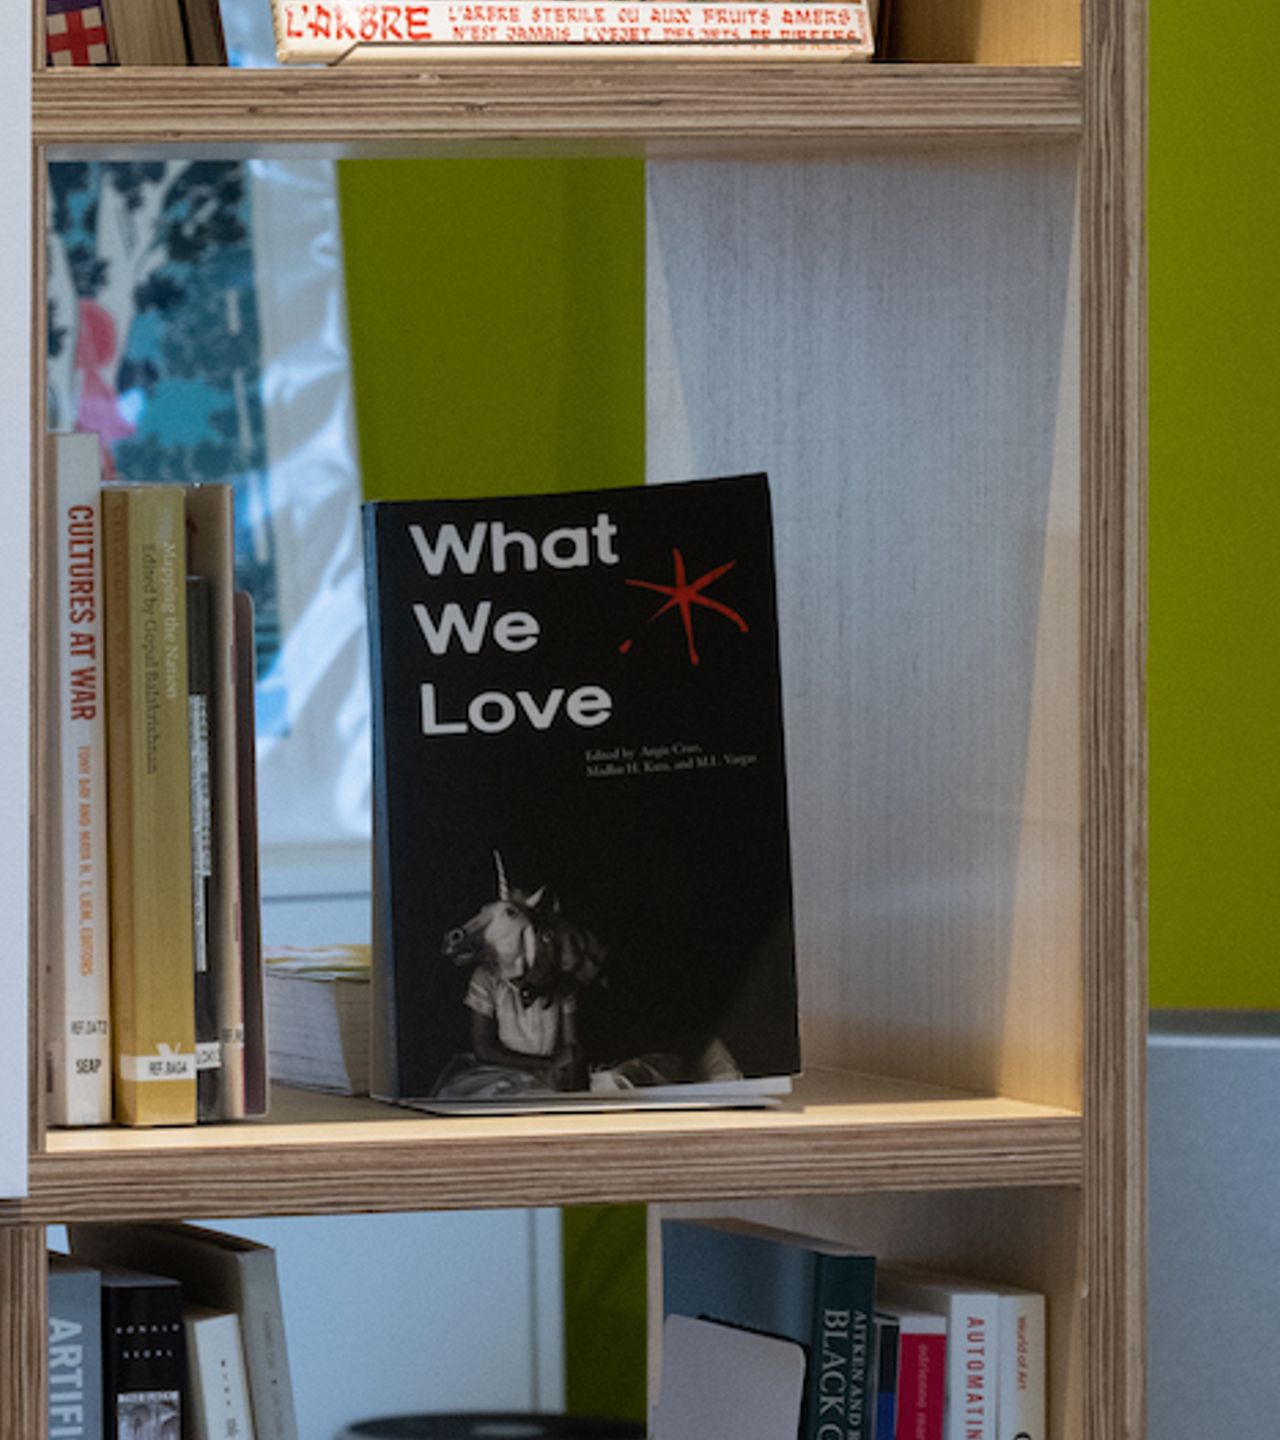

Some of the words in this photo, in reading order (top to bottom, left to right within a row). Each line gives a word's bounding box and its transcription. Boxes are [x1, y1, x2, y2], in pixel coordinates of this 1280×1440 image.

[67, 504, 96, 627] CULTURES
[407, 511, 620, 576] What
[69, 631, 96, 666] AT
[412, 600, 541, 655] We
[69, 667, 97, 722] WAR
[420, 682, 613, 736] Love
[817, 1308, 850, 1420] BLACK
[850, 1310, 868, 1376] AITKEN
